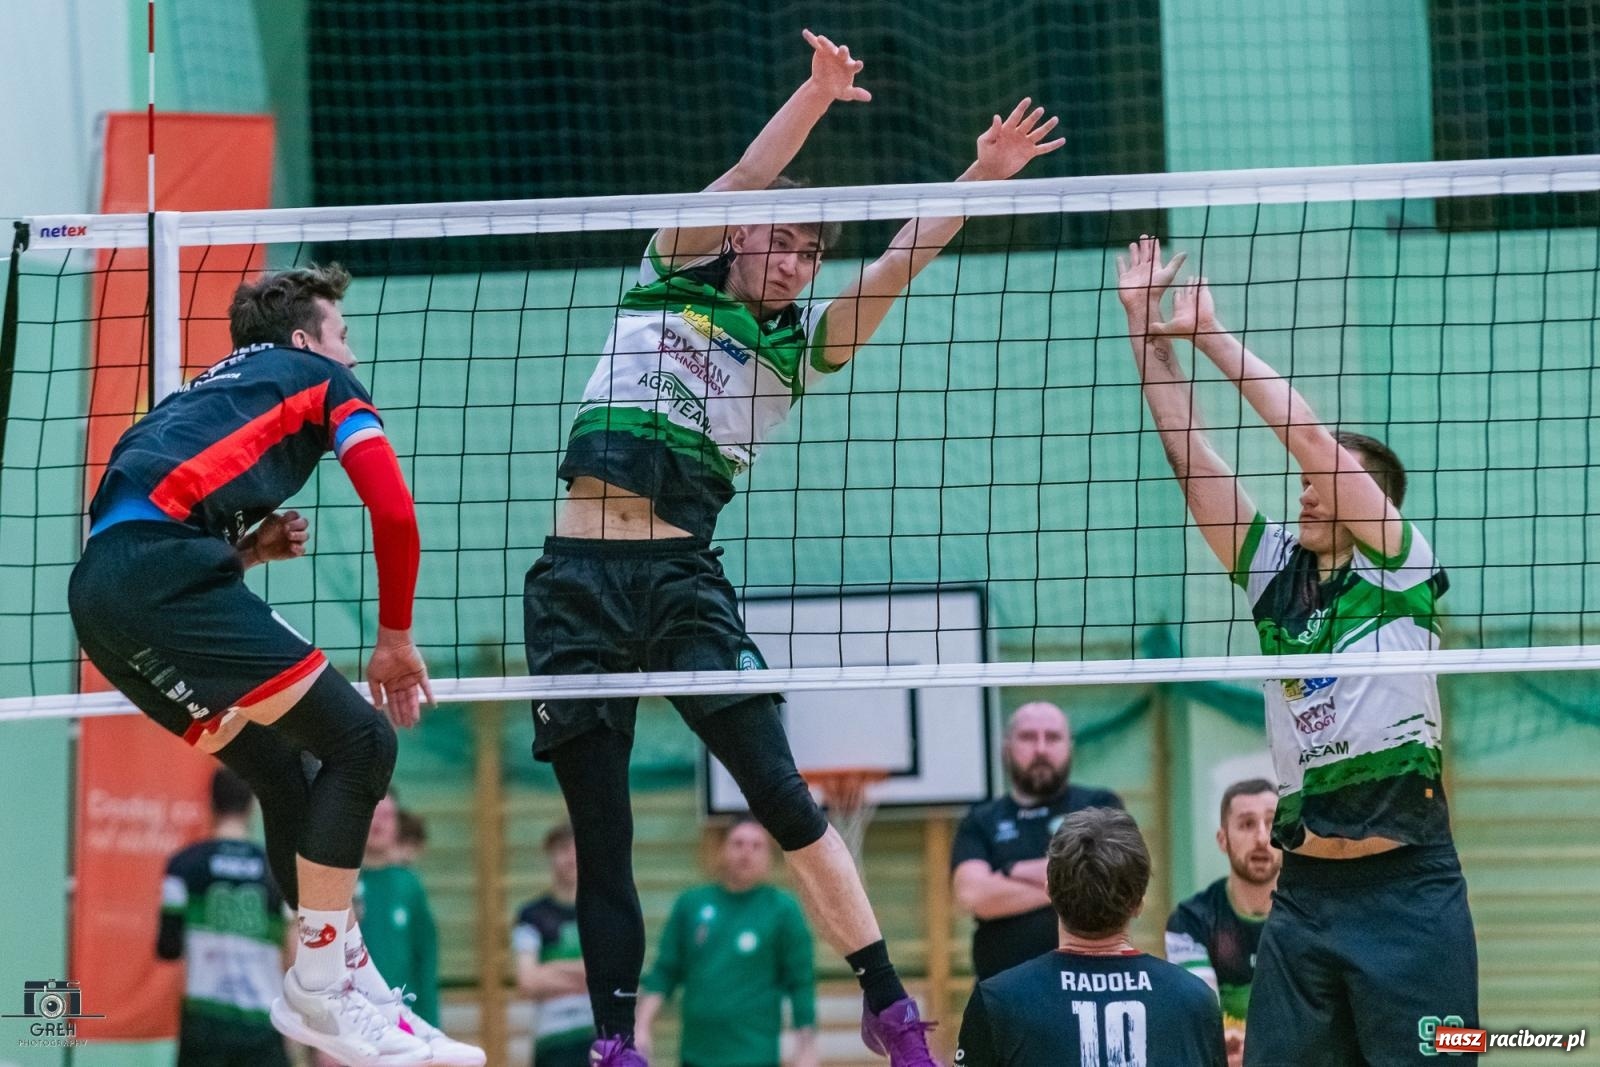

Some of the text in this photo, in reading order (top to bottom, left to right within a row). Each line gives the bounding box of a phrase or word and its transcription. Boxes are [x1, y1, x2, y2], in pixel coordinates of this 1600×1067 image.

[40, 224, 87, 238] netex
[1060, 970, 1153, 992] RADOŁA
[1071, 1000, 1147, 1067] 10
